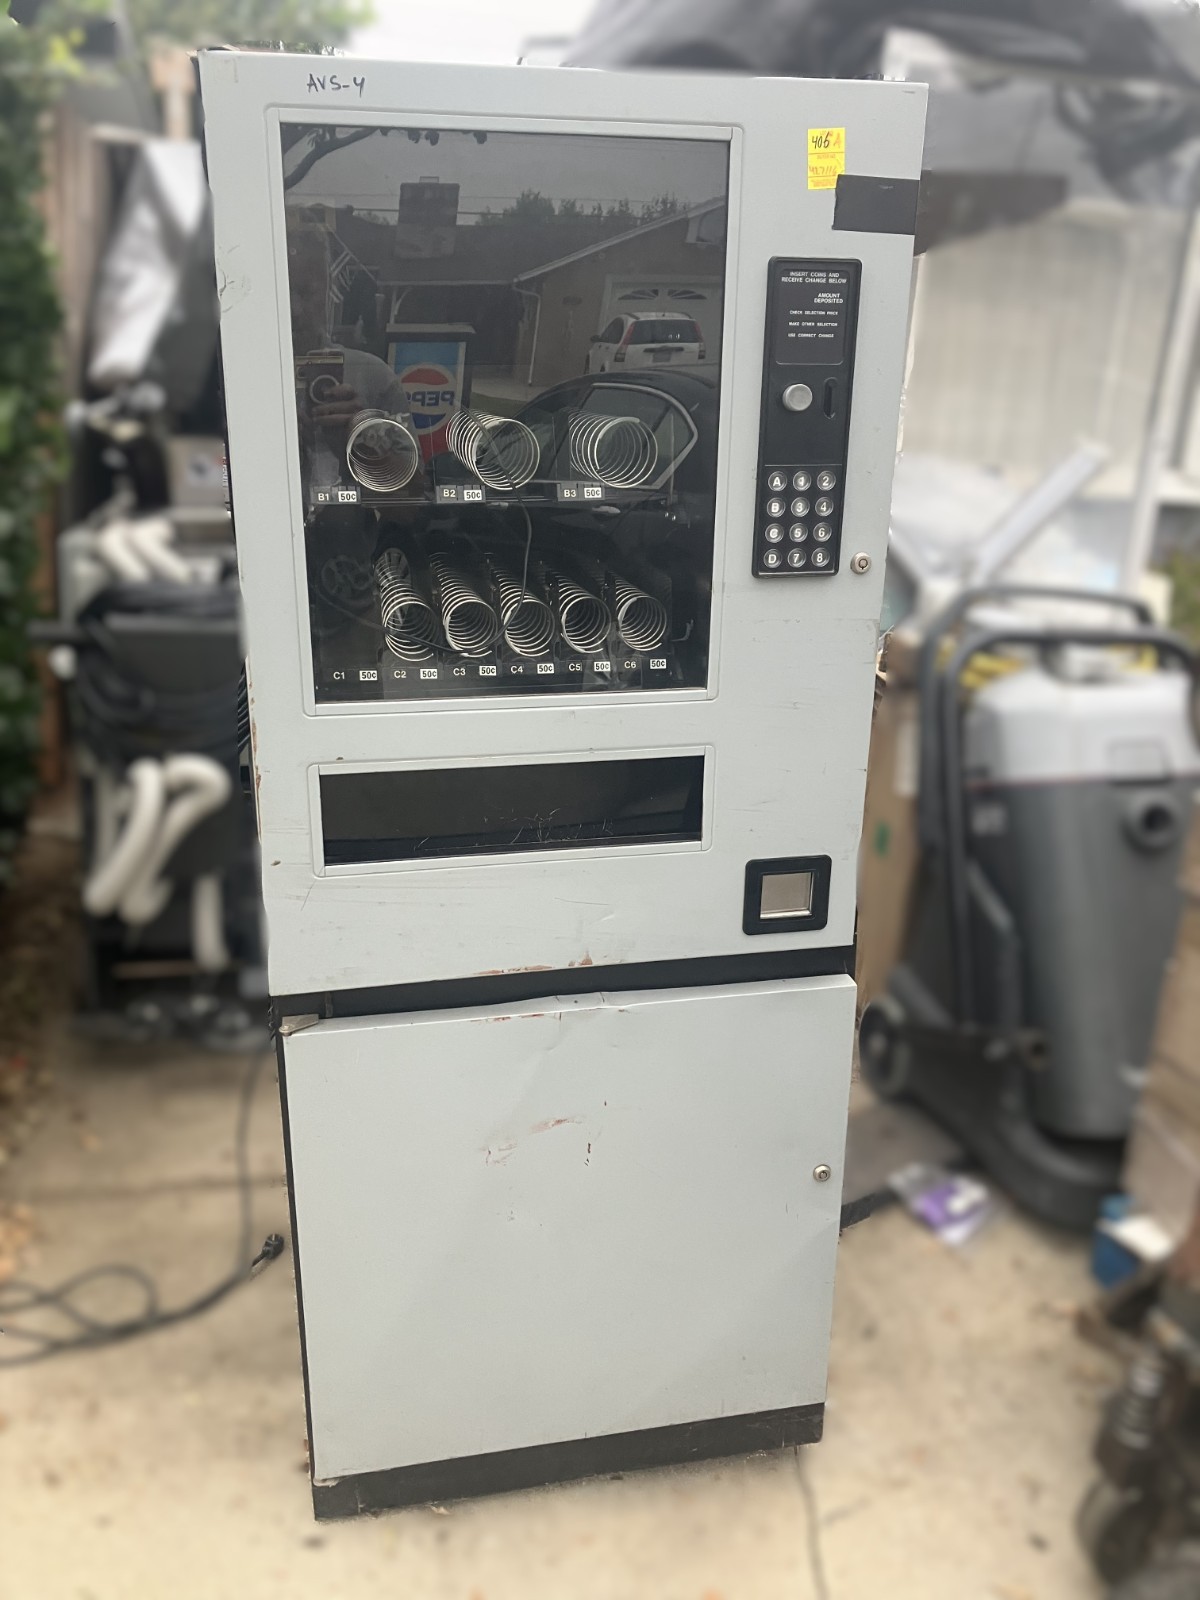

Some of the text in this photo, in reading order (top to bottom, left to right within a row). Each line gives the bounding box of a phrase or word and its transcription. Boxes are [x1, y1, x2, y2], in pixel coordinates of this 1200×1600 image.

[811, 131, 830, 149] 406
[772, 475, 830, 487] A 1 2
[318, 493, 329, 501] B1
[443, 488, 457, 498] B2
[563, 489, 577, 498] B3
[771, 501, 827, 513] B 3 4
[769, 527, 825, 539] C 5 6
[768, 552, 823, 564] D 7 8
[568, 663, 581, 671] C5
[624, 660, 637, 669] C6
[453, 667, 466, 676] C3
[510, 665, 524, 674] C4
[333, 671, 345, 680] C1
[393, 670, 407, 679] C2
